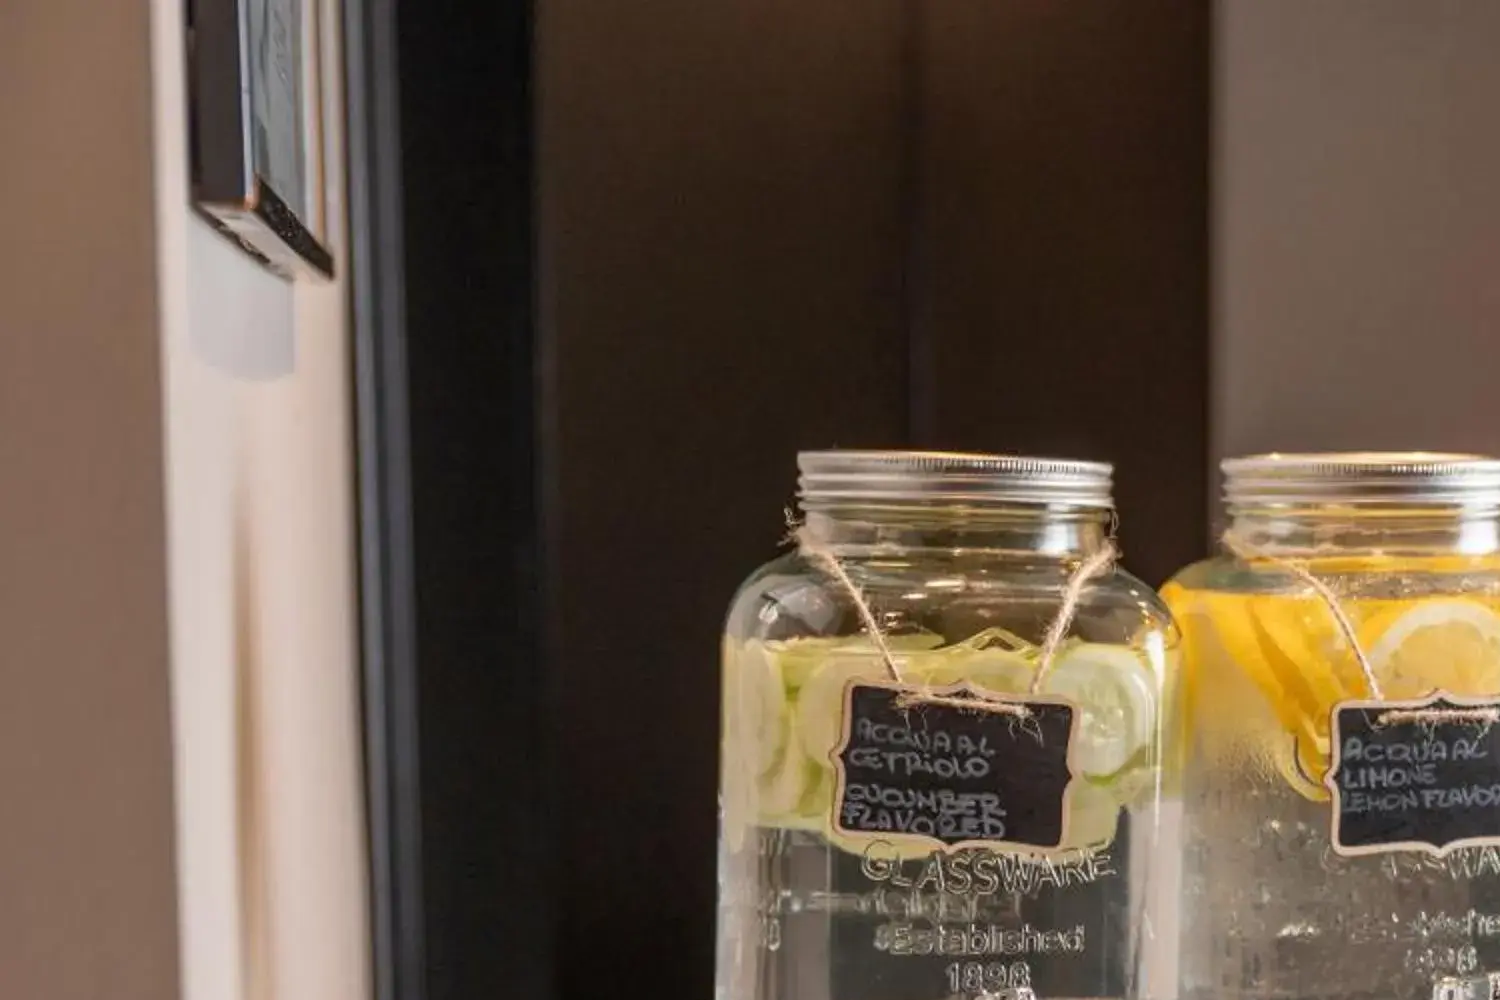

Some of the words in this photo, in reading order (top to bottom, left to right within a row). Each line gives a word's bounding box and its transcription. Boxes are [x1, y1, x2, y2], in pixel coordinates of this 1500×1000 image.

[1342, 737, 1447, 762] ACQUA
[861, 839, 1117, 895] GLASSWARE
[888, 922, 1086, 956] Established
[946, 961, 1032, 992] 1898
